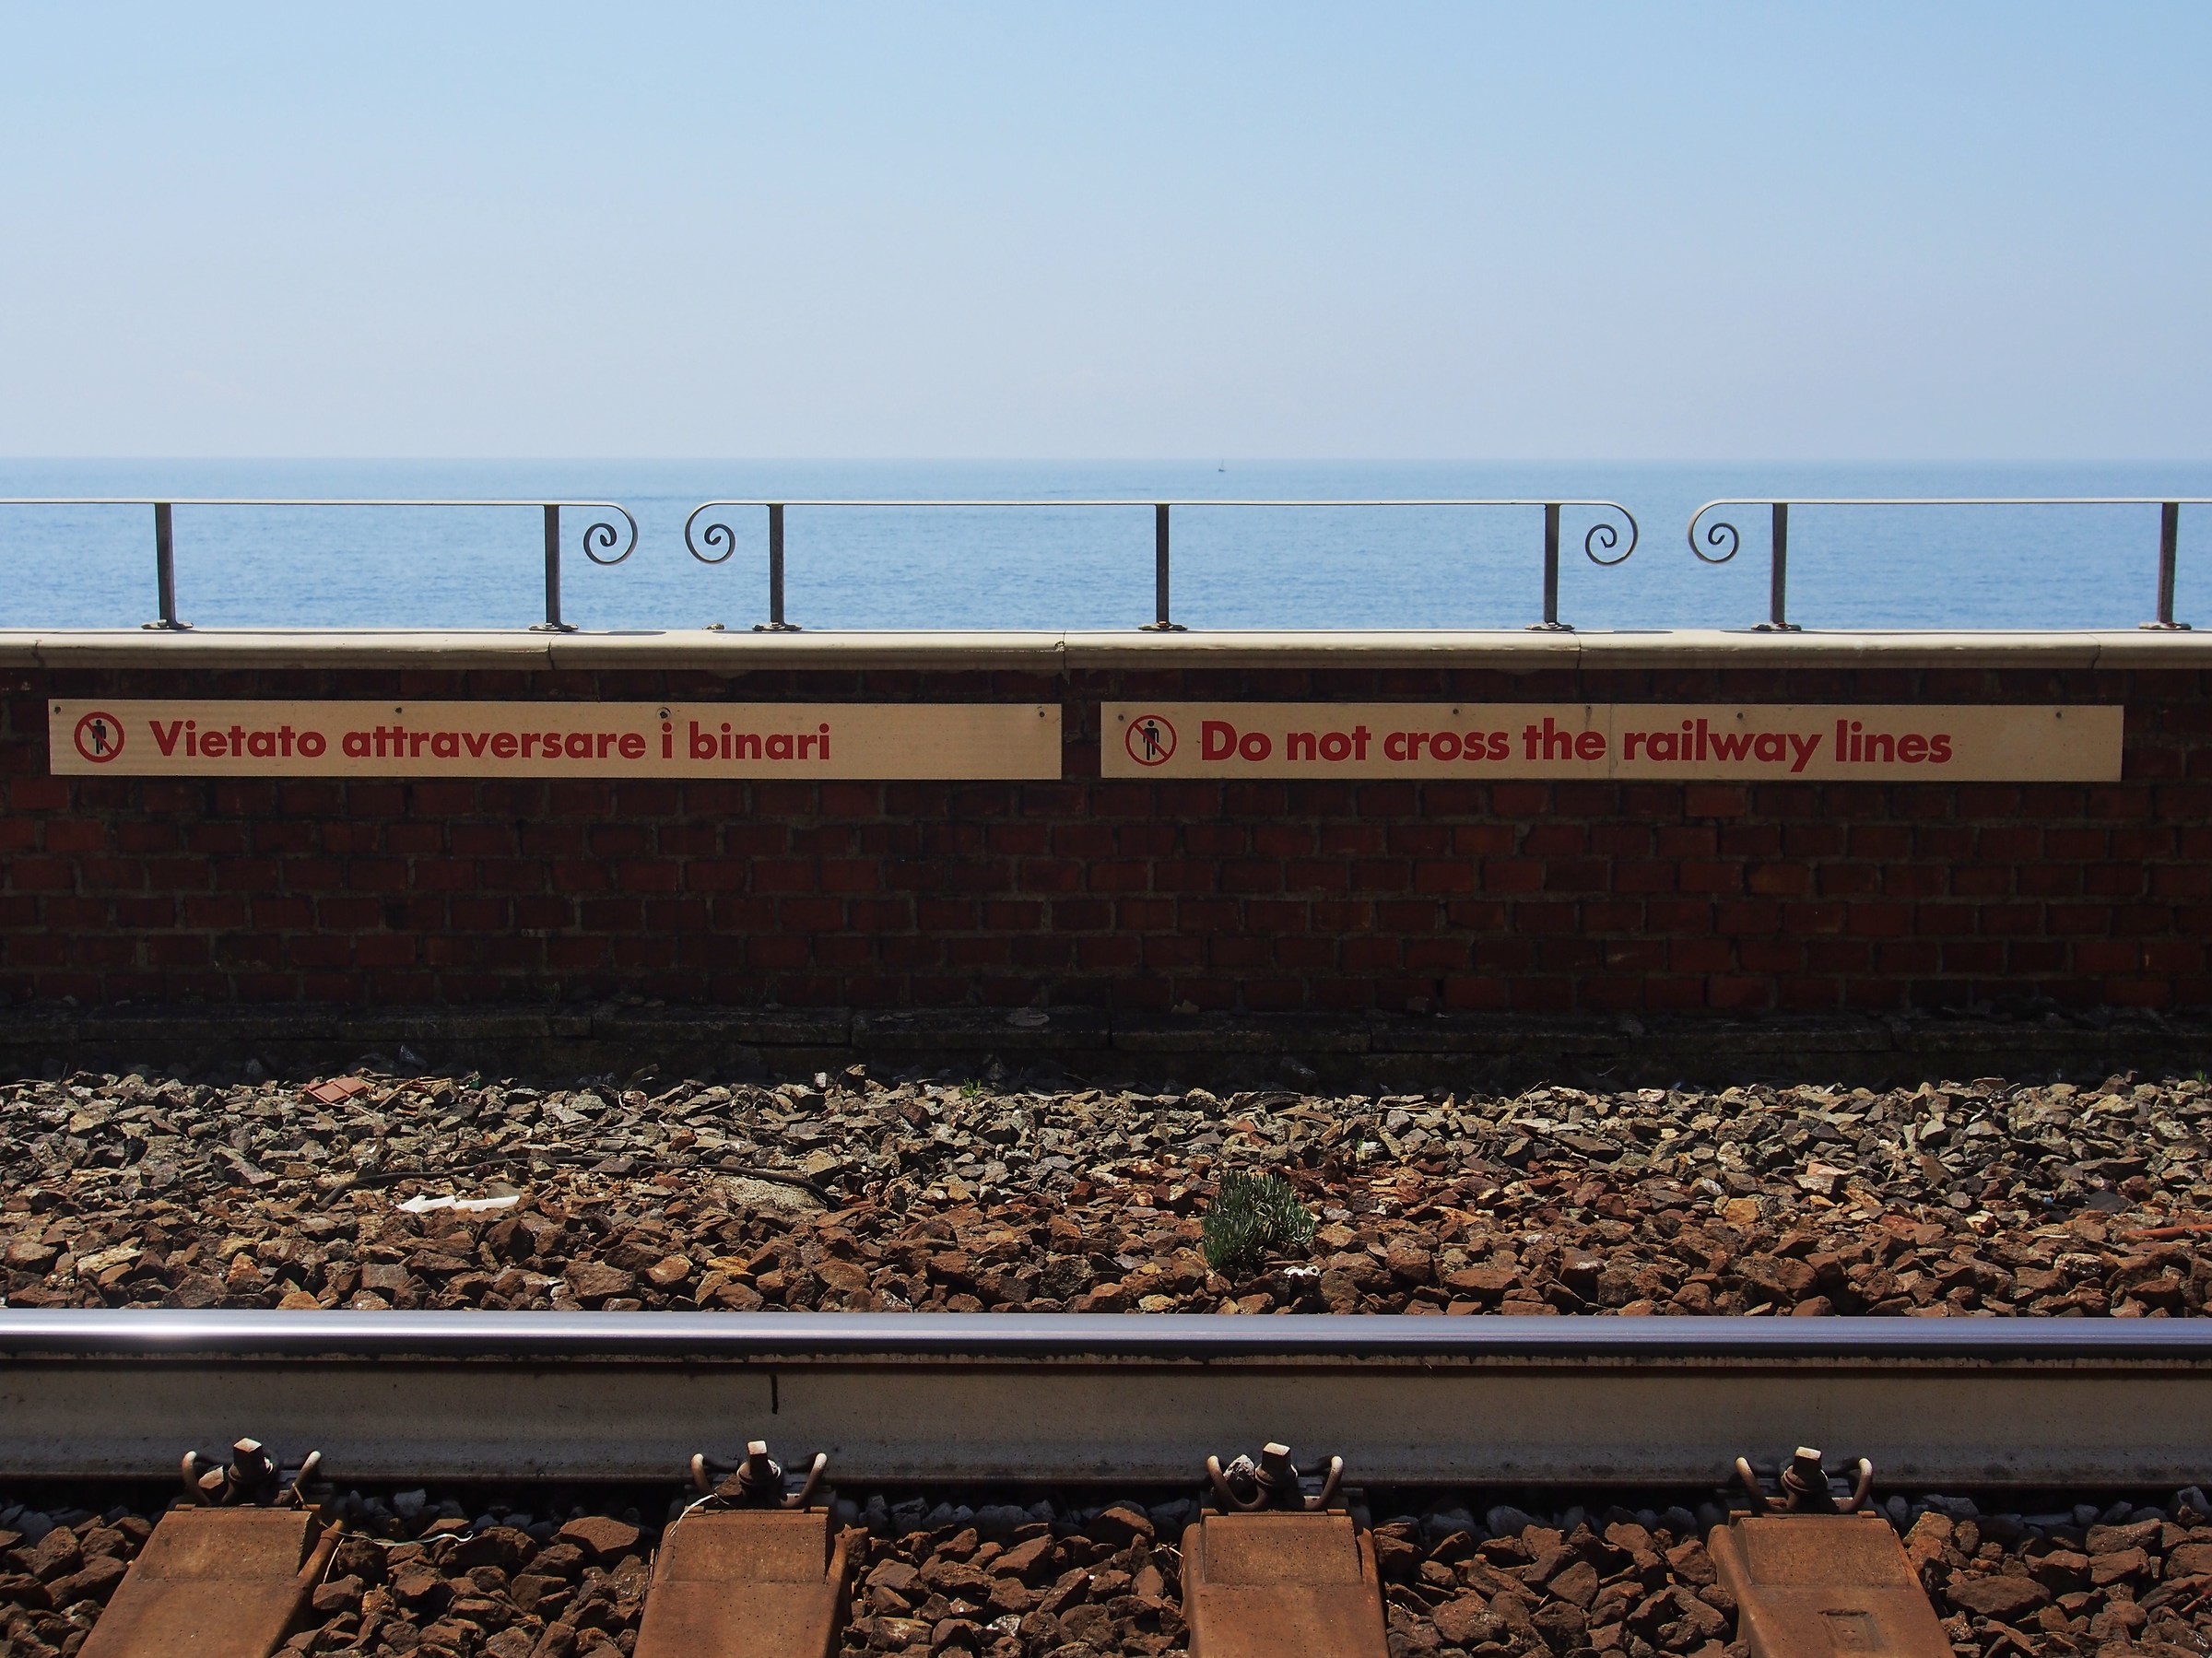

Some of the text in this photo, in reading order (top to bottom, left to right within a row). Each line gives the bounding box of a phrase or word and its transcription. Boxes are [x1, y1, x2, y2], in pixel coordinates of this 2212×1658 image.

[148, 720, 830, 760] Vietato attraversare i binari
[1201, 717, 1952, 772] Do not cross the railway lines
